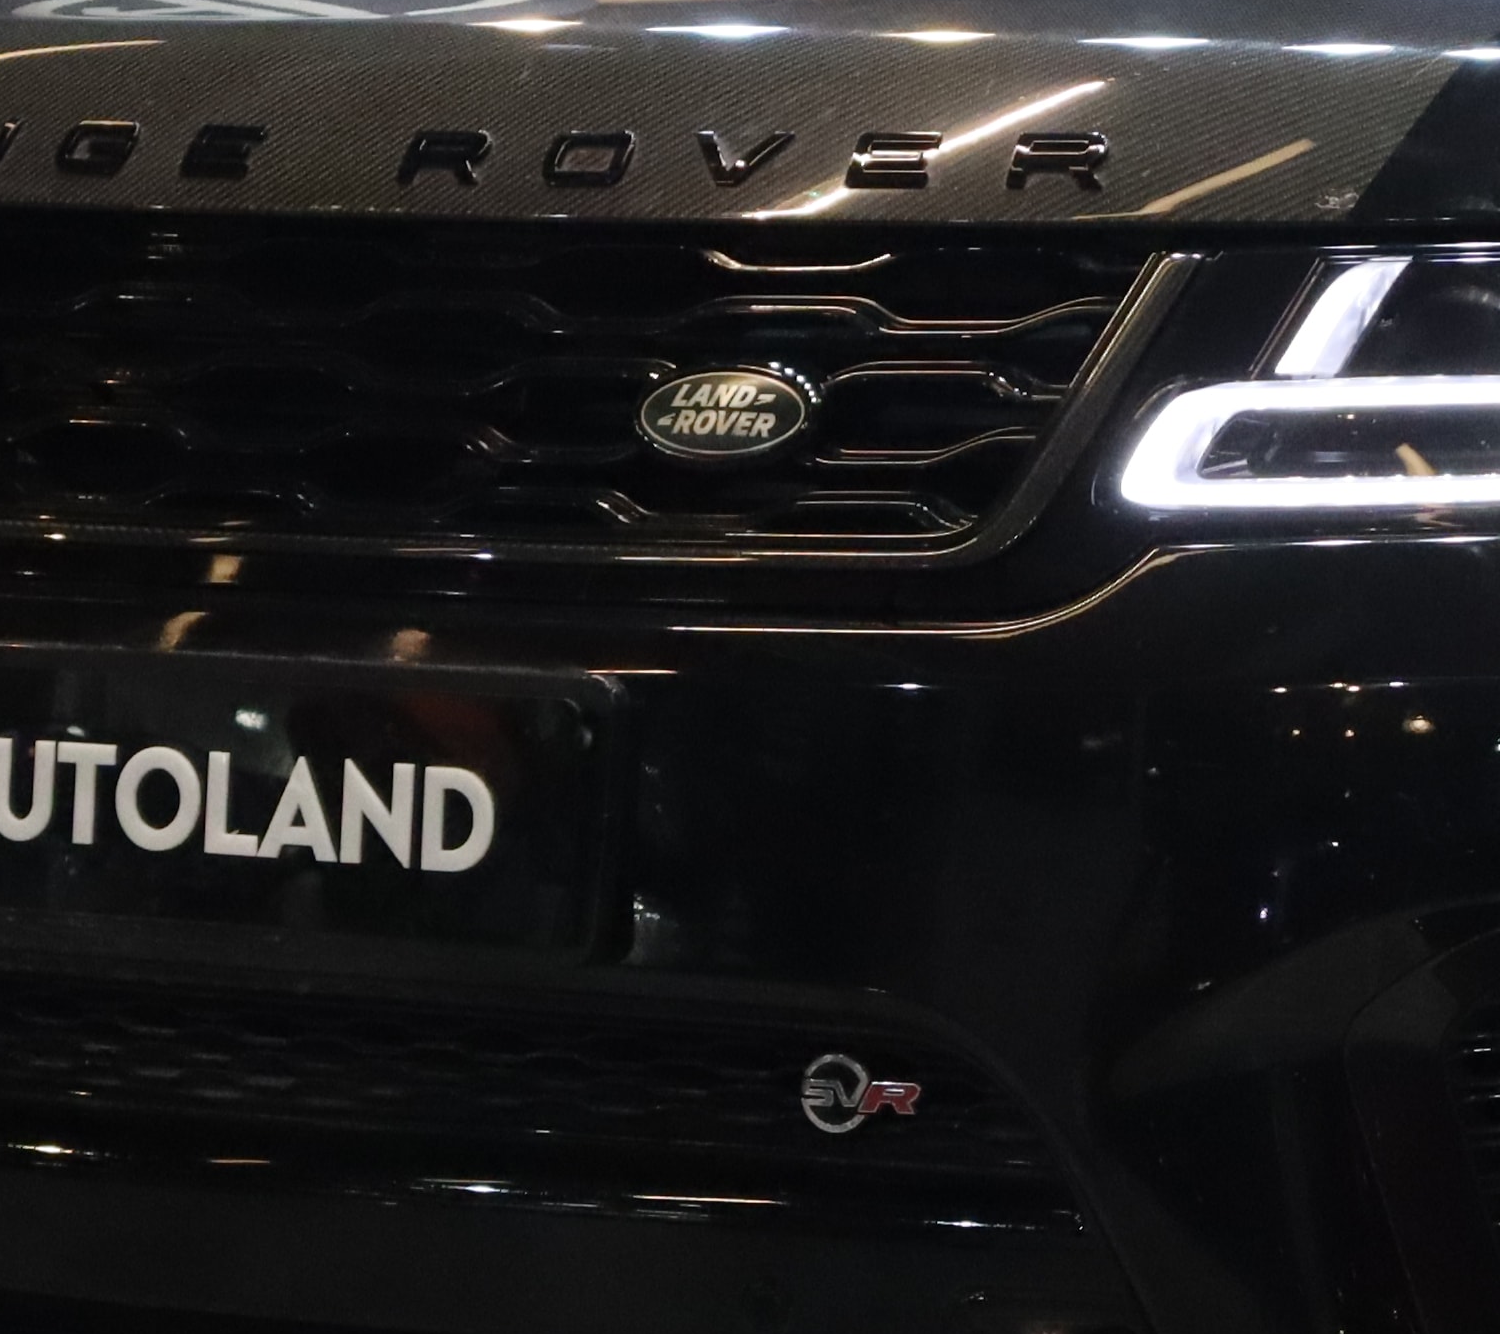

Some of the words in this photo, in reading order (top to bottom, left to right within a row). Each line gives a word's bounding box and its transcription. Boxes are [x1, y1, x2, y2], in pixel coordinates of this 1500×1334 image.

[396, 129, 1111, 192] ROVER
[671, 383, 758, 408] LAND
[671, 409, 777, 438] ROVER
